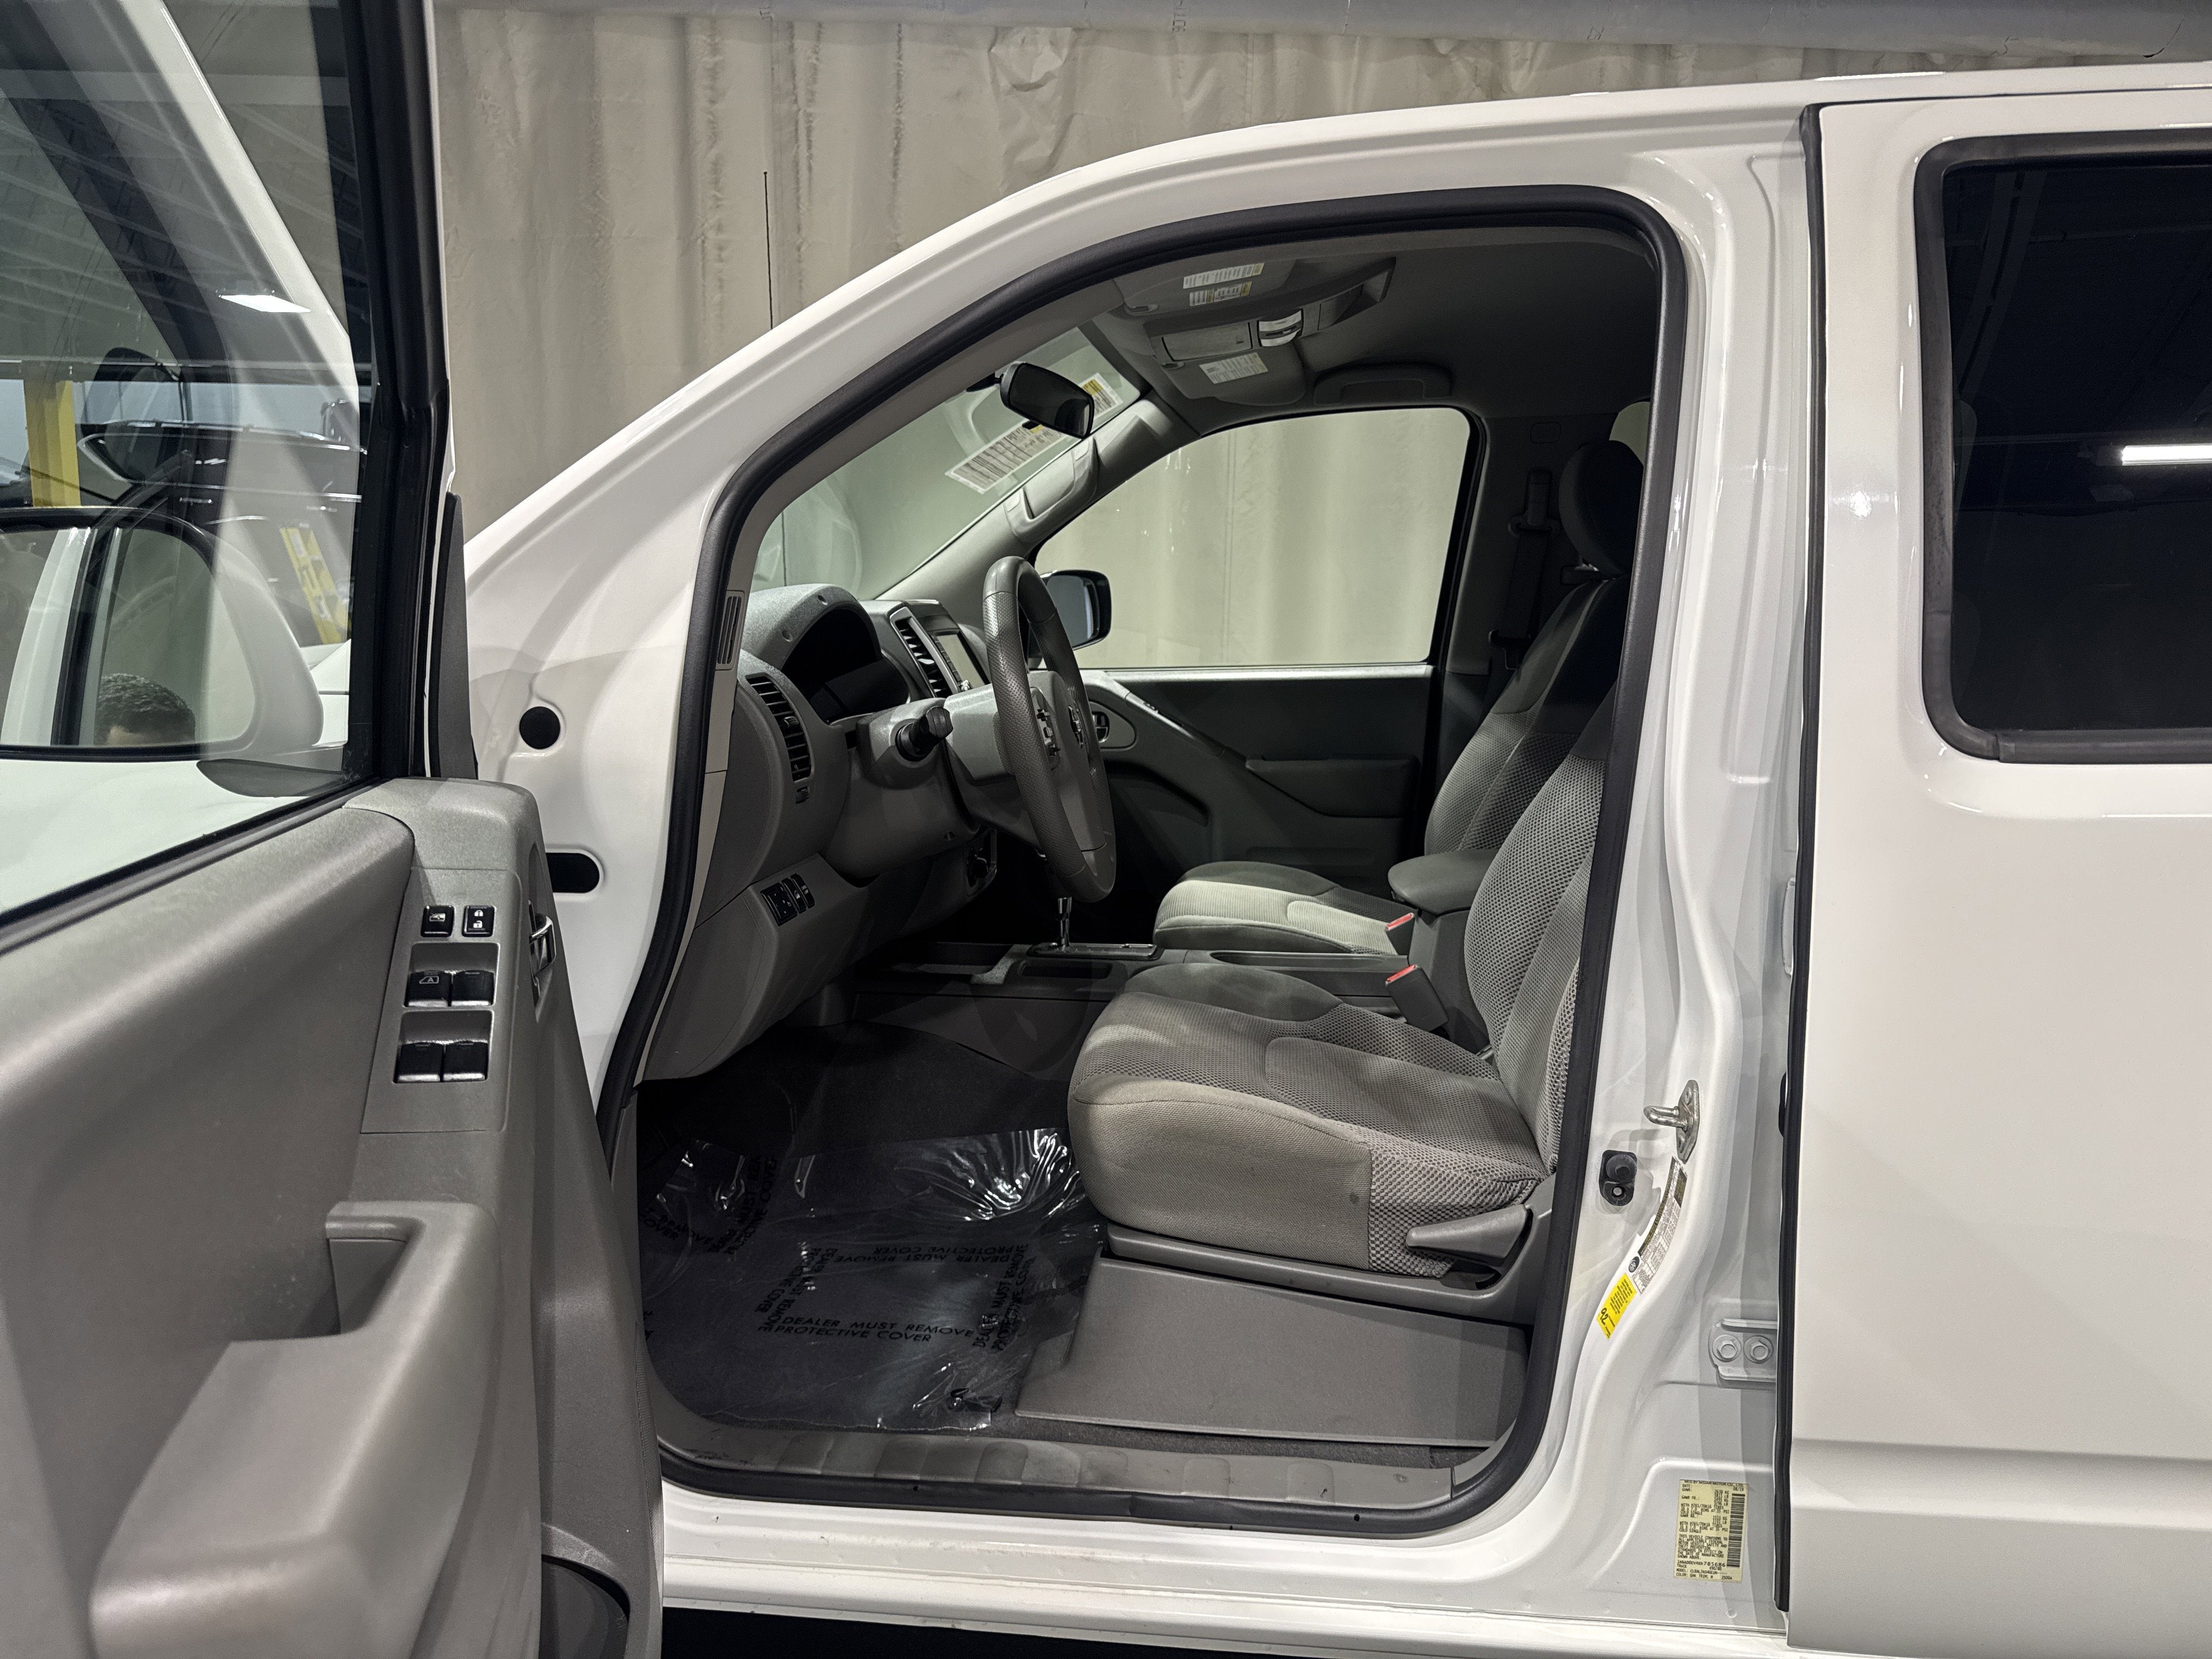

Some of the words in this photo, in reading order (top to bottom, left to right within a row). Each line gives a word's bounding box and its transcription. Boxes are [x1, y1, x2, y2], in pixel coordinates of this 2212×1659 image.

[991, 1281, 1012, 1308] MUST
[775, 1325, 870, 1338] PROTECTIVE
[877, 1330, 932, 1342] COVER
[782, 1317, 840, 1327] DEALER
[850, 1321, 897, 1330] MUST
[906, 1324, 975, 1337] REMOVE
